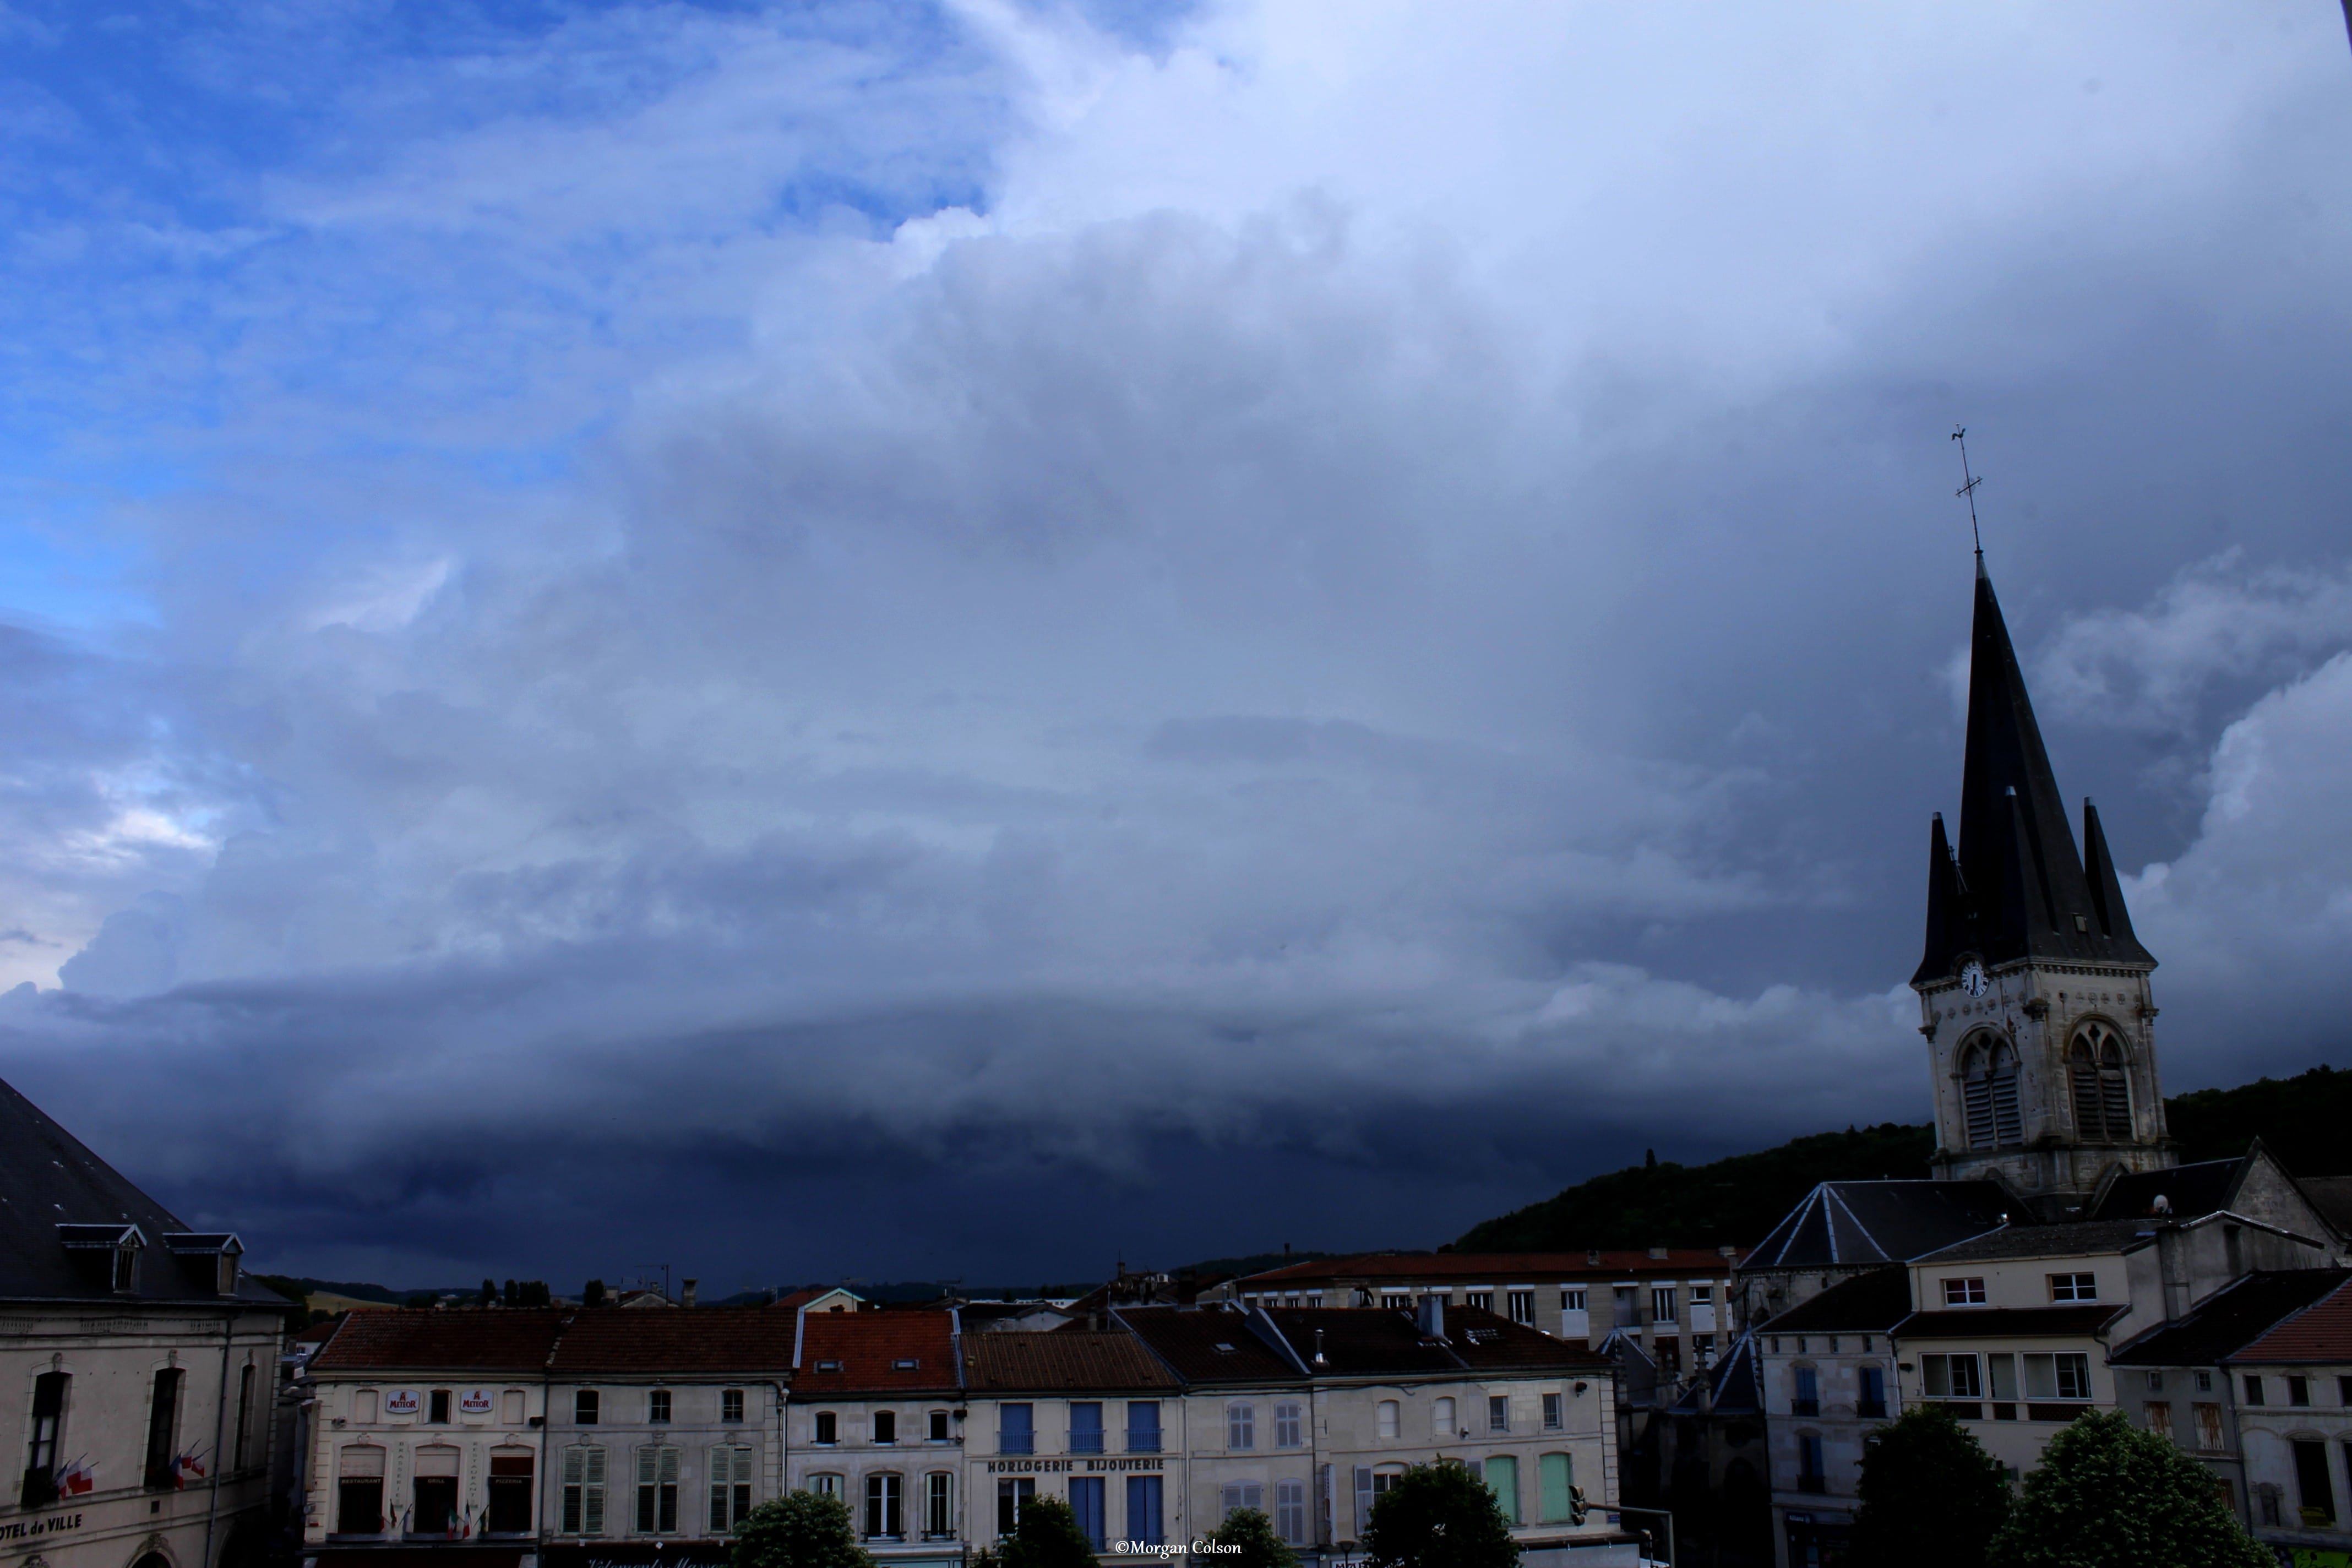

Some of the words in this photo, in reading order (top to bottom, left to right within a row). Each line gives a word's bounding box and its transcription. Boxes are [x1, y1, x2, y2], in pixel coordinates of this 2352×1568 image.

[390, 1400, 416, 1408] METEOR
[462, 1400, 489, 1408] METEOR
[988, 1460, 1073, 1473] HORLOGERIE
[1087, 1459, 1163, 1471] BIJOUTERIE
[30, 1521, 44, 1535] de
[48, 1514, 82, 1532] VILLE
